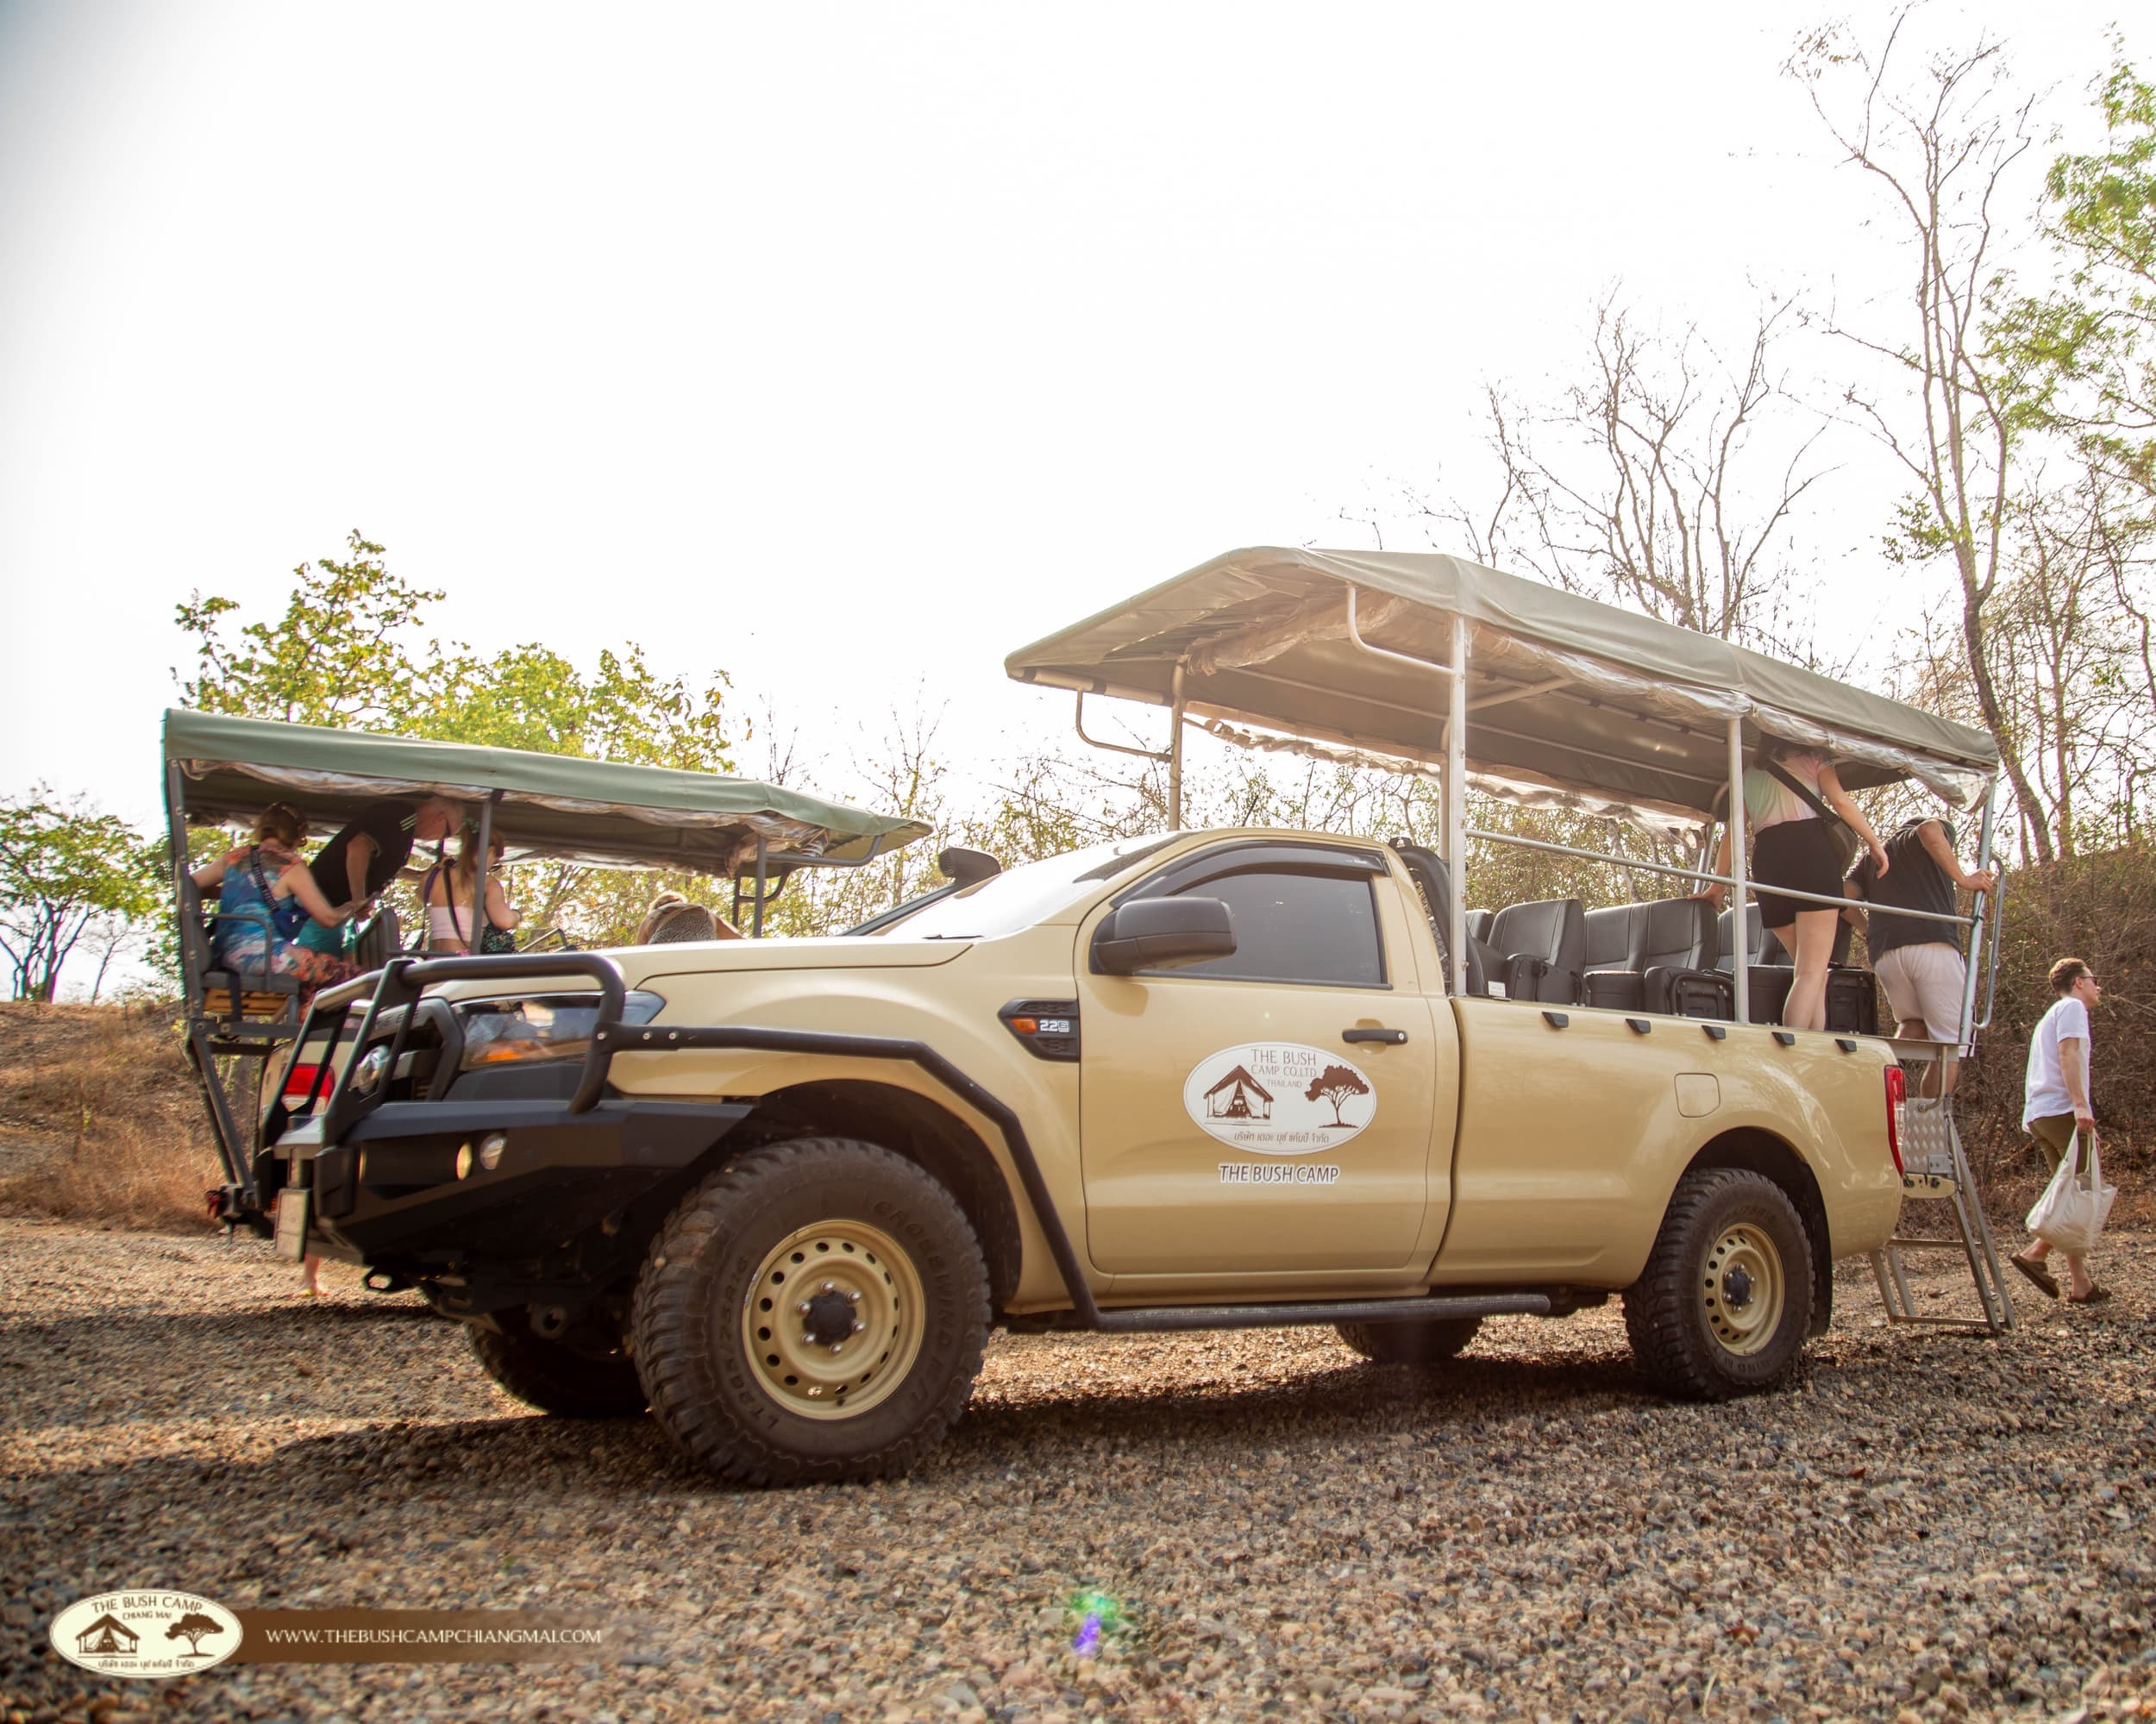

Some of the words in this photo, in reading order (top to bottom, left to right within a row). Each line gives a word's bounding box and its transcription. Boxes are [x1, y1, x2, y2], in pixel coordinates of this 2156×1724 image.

[1250, 1049, 1277, 1063] THE
[1282, 1050, 1316, 1067] BUSH
[1250, 1064, 1279, 1075] CAMP
[1267, 1079, 1303, 1088] THAILAND
[1219, 1165, 1250, 1182] THE
[1252, 1165, 1294, 1182] BUSH
[1296, 1166, 1339, 1183] CAMP
